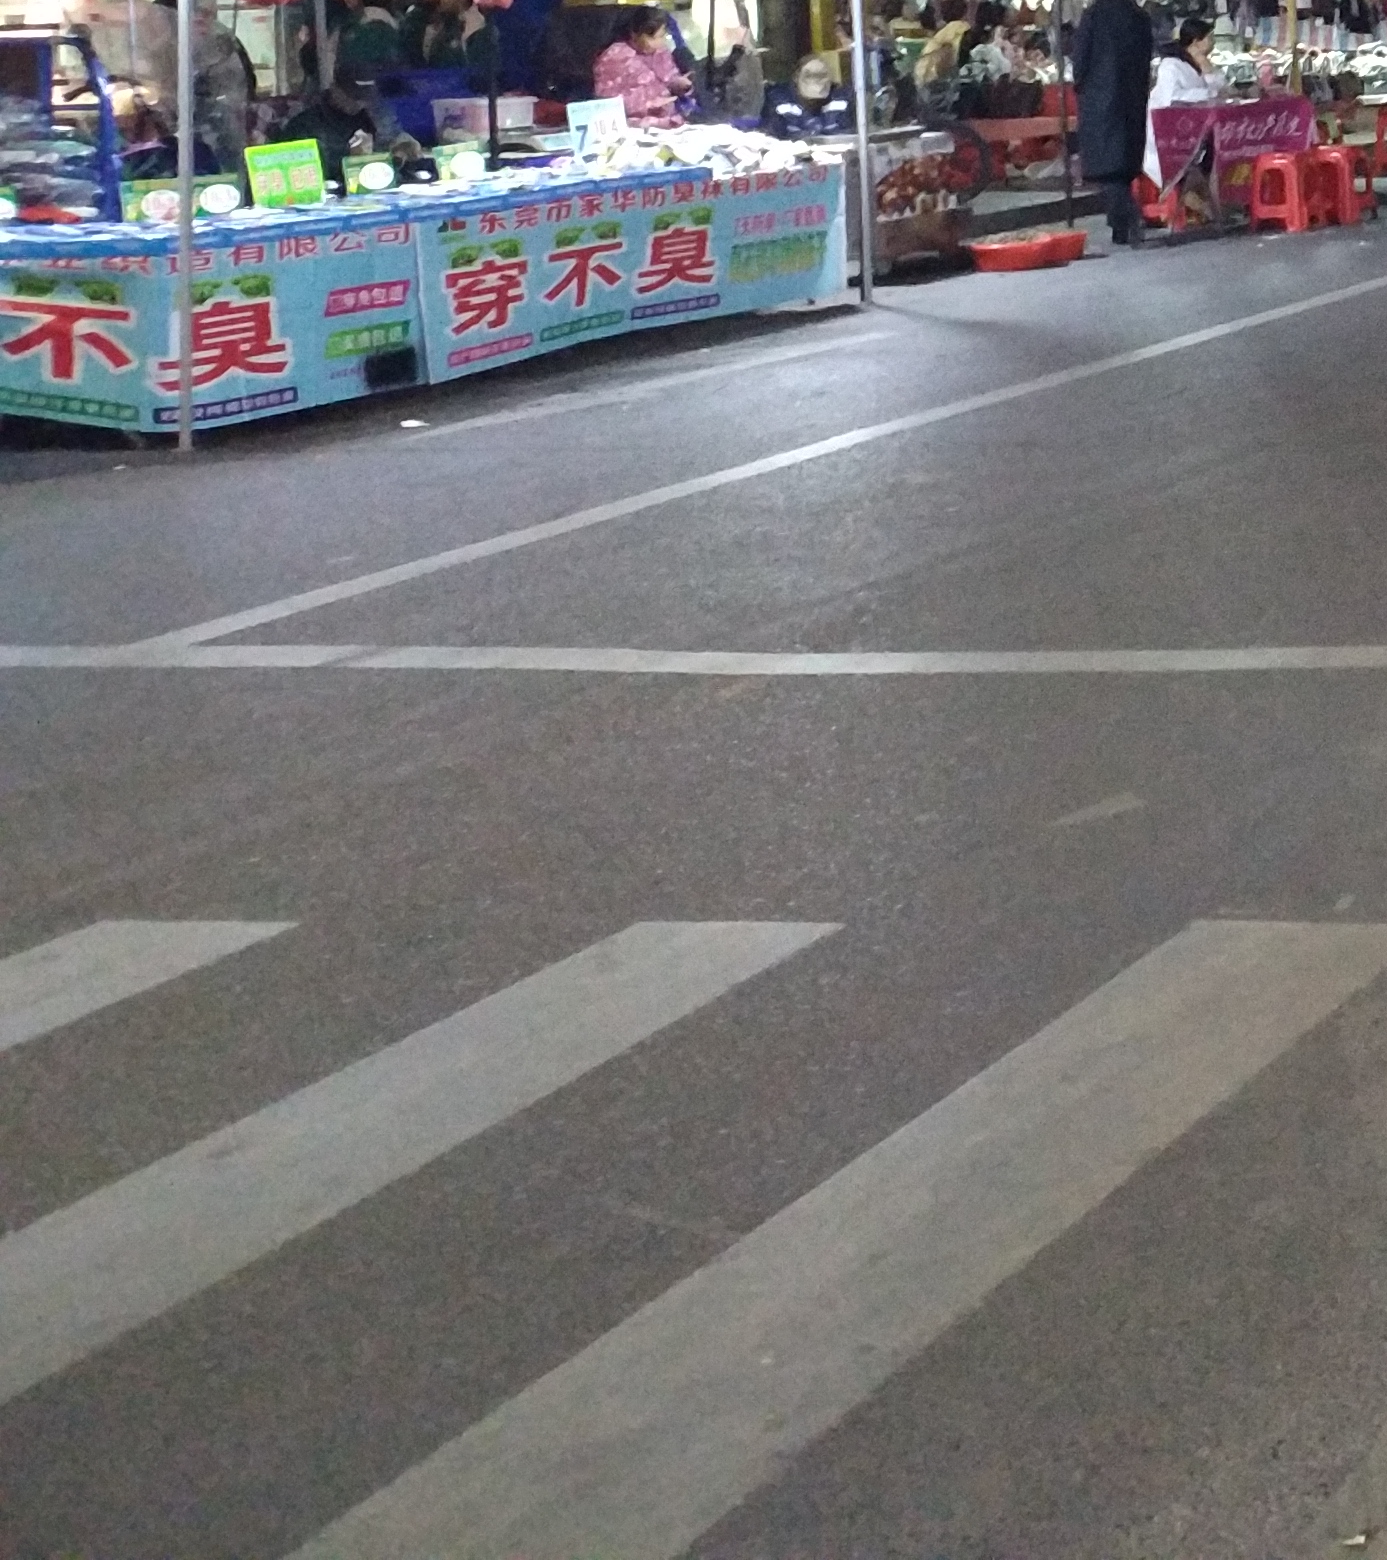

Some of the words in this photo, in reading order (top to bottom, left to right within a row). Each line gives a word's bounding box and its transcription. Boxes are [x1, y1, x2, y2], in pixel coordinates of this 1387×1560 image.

[445, 226, 717, 335] 穿不臭
[0, 299, 290, 392] 不臭
